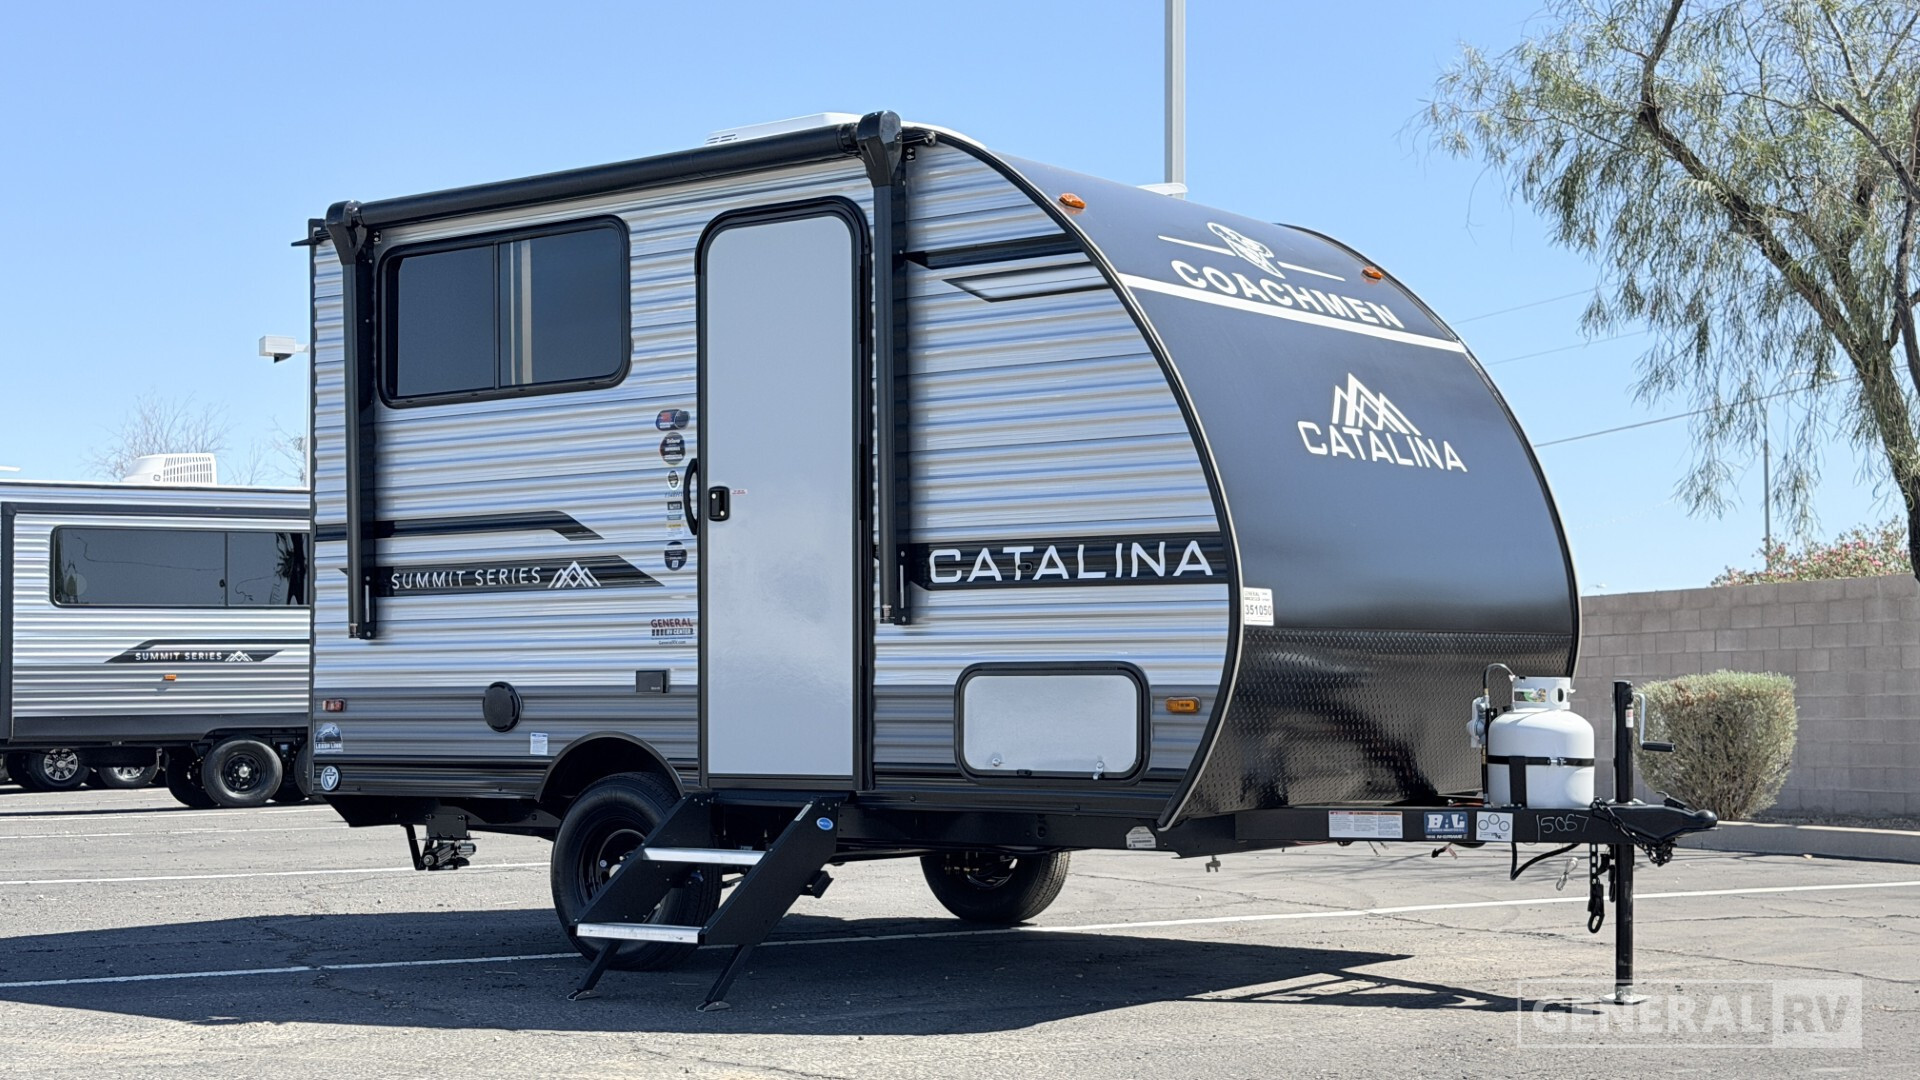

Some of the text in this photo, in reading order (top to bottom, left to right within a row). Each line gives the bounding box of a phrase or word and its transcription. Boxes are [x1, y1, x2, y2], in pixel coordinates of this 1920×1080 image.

[1171, 259, 1405, 329] COACHMEN
[1297, 420, 1468, 473] CATALINA
[929, 540, 1213, 583] CATALINA
[391, 566, 541, 590] SUMMIT SERIES
[650, 618, 694, 628] GENERAL
[1245, 604, 1273, 616] 351050
[135, 652, 223, 661] SUMMIT SERIES
[1536, 813, 1589, 841] 15067
